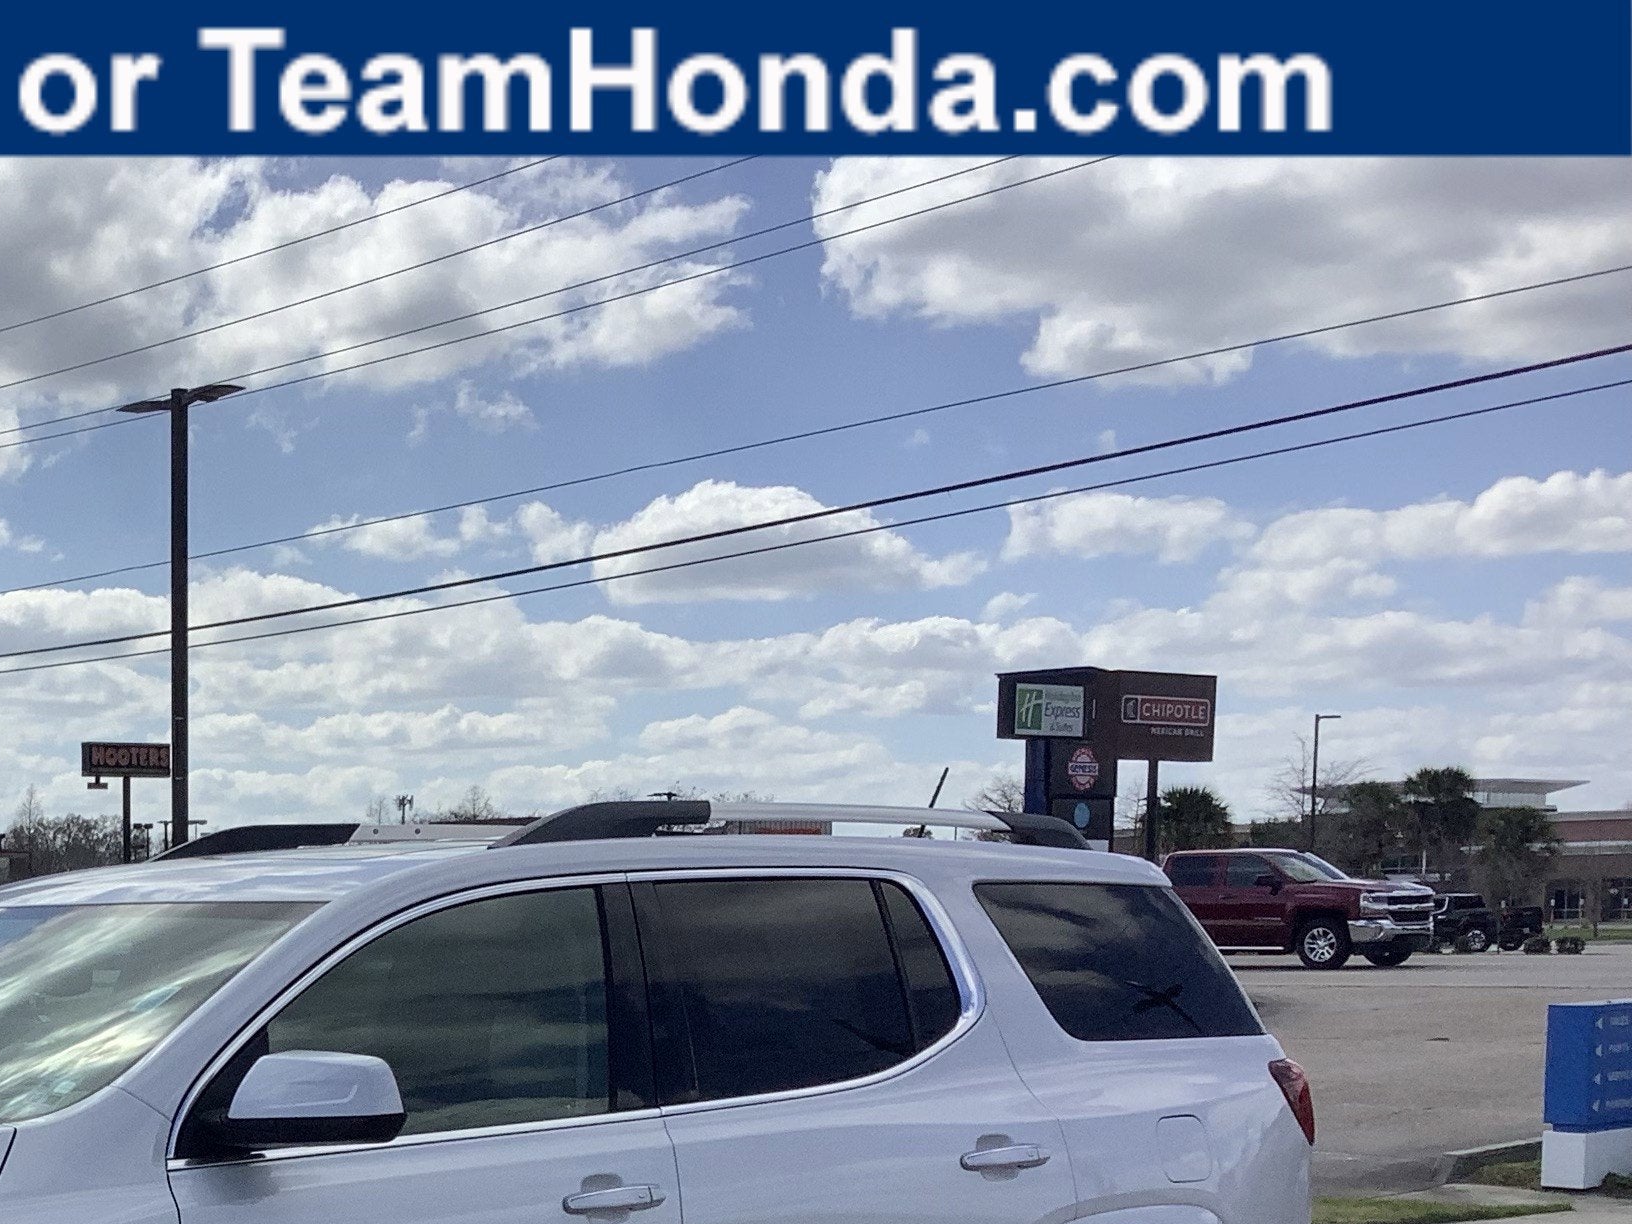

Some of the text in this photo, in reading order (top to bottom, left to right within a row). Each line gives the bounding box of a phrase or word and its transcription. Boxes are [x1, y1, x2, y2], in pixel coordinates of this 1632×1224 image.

[1044, 702, 1081, 721] Express
[1142, 702, 1206, 719] CHIPOTLE
[91, 745, 169, 767] HOOTERS
